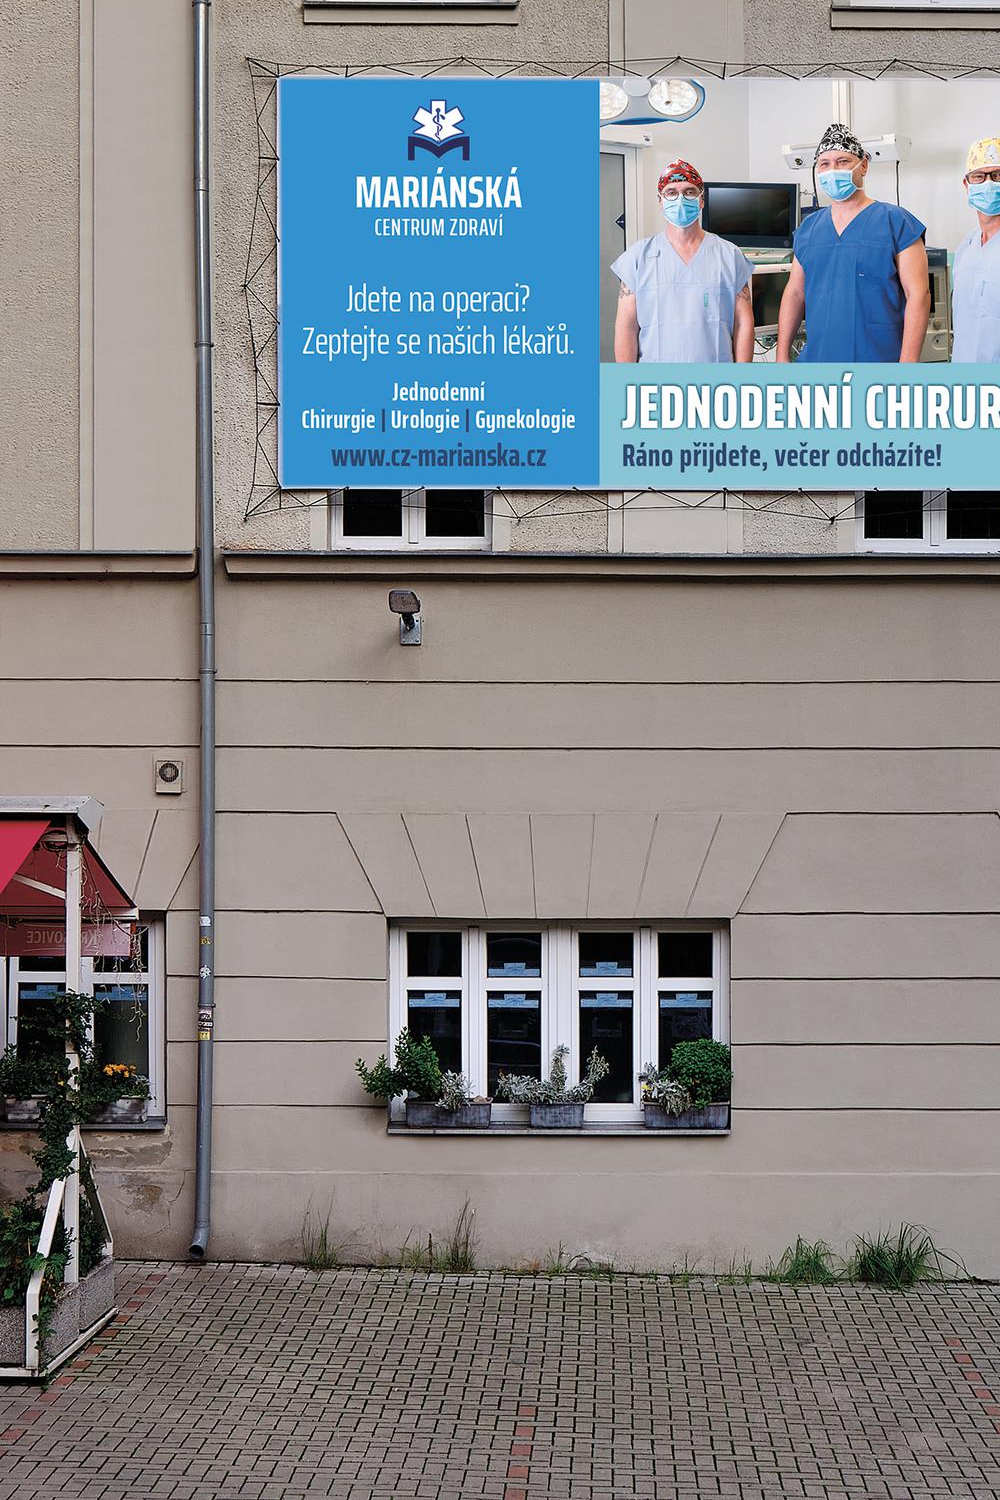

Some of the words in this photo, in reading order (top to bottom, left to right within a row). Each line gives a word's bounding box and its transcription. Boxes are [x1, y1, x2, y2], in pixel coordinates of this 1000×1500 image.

[356, 167, 523, 208] MARIÁNSKÁ
[374, 218, 445, 237] CENTRUM
[450, 214, 504, 237] ZDRAVÍ
[346, 283, 402, 313] Jdete
[409, 291, 435, 313] na
[442, 283, 531, 320] operaci?
[302, 325, 389, 362] Zeptejte
[396, 333, 421, 355] se
[428, 324, 496, 355] našich
[503, 322, 575, 355] lékařů.
[391, 380, 486, 402] Jednodenní
[621, 371, 853, 431] JEDNODENNÍ
[301, 408, 376, 434] Chirurgie
[391, 408, 460, 434] Urologie
[475, 408, 576, 434] Gynekologie
[331, 443, 547, 467] www.cz-marianska.cz
[622, 442, 673, 467] Ráno
[680, 442, 768, 474] přijdete,
[774, 442, 831, 467] večer
[836, 442, 942, 467] odcházíte!
